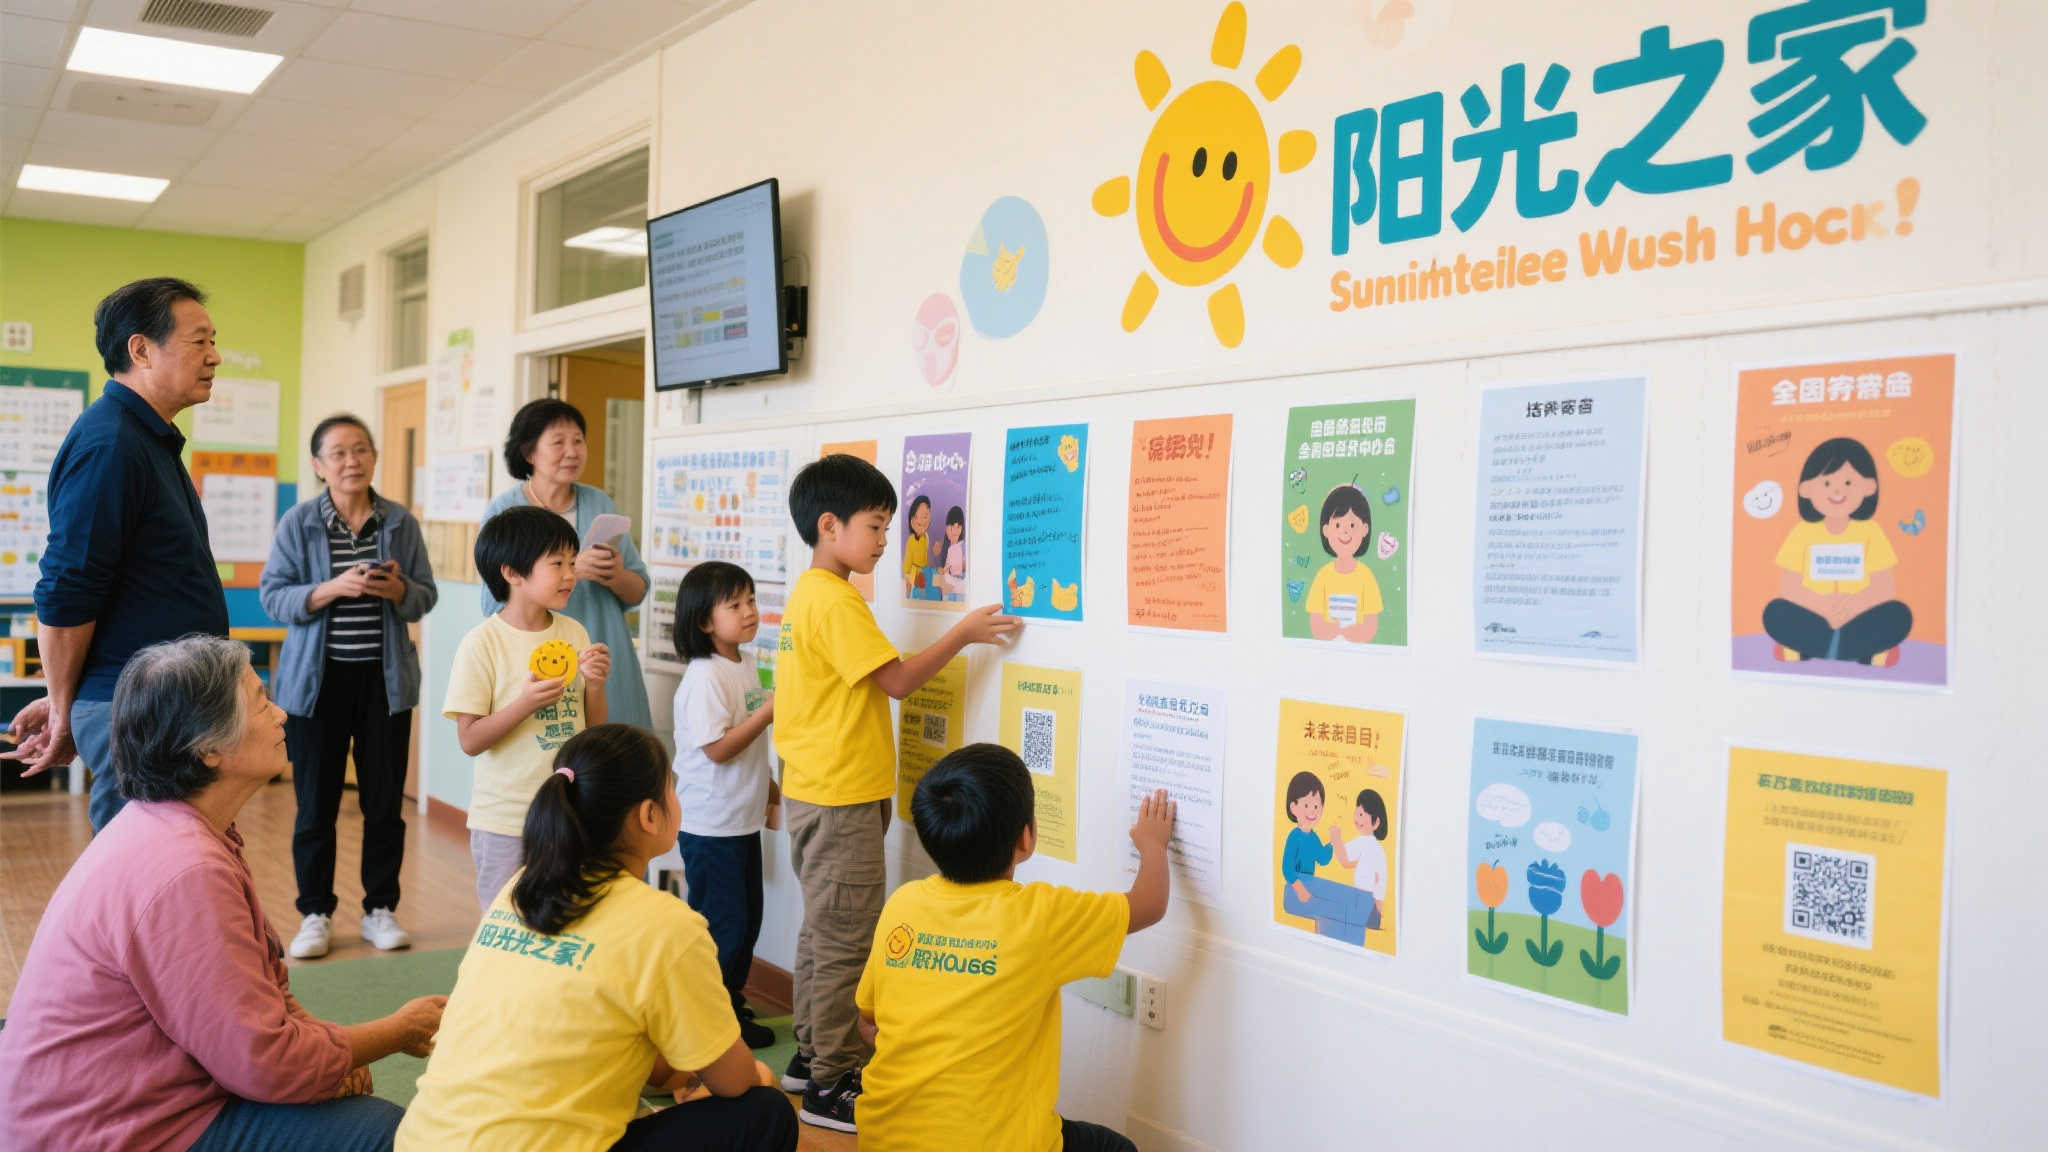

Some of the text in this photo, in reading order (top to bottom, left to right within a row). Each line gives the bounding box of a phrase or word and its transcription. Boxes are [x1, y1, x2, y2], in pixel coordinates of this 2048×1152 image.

[1331, 0, 1928, 256] 阳光之家
[1579, 215, 1716, 278] Wush
